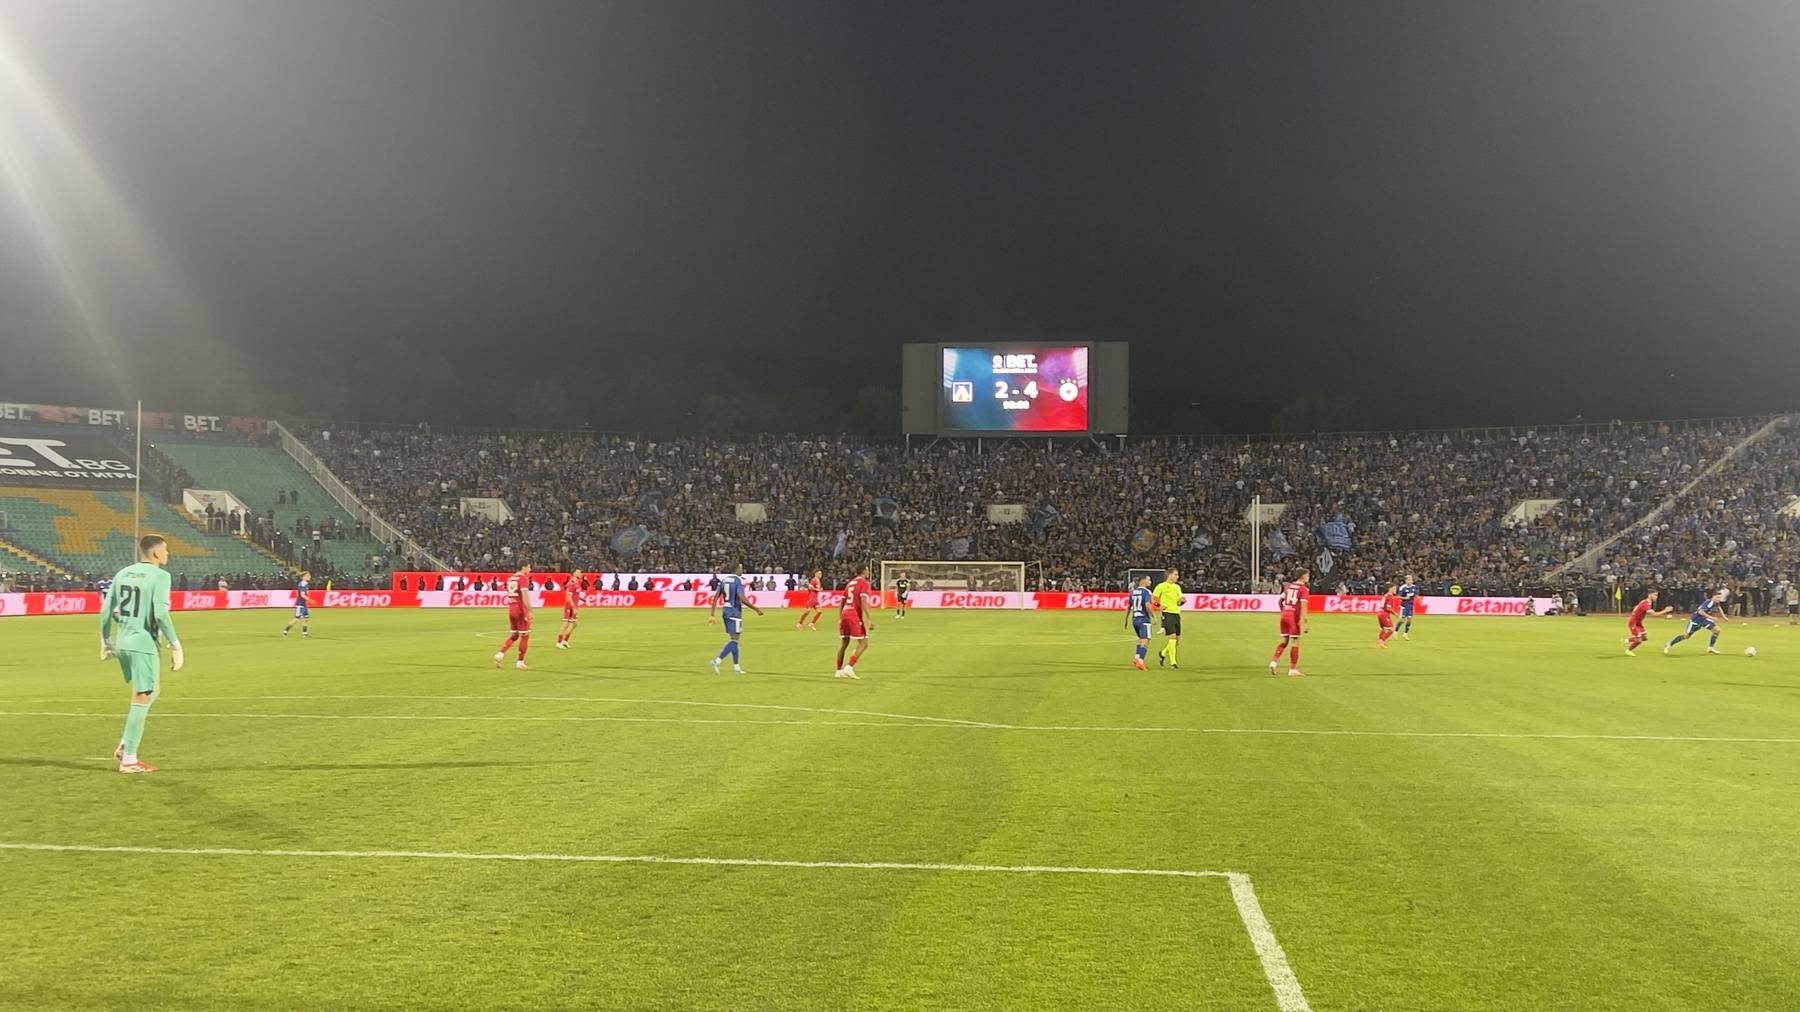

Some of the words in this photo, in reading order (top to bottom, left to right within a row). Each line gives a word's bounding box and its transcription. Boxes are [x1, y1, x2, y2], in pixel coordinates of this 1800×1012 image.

[995, 381, 1009, 398] 2
[1023, 381, 1039, 398] 4
[0, 468, 64, 478] ОВЕЧЕ
[44, 593, 86, 612] Betano
[120, 584, 141, 618] 21
[323, 591, 391, 607] Betano
[940, 592, 1006, 608] Betano
[1194, 594, 1261, 611] Betano
[1323, 595, 1382, 612] Betan
[1456, 599, 1527, 614] Betano
